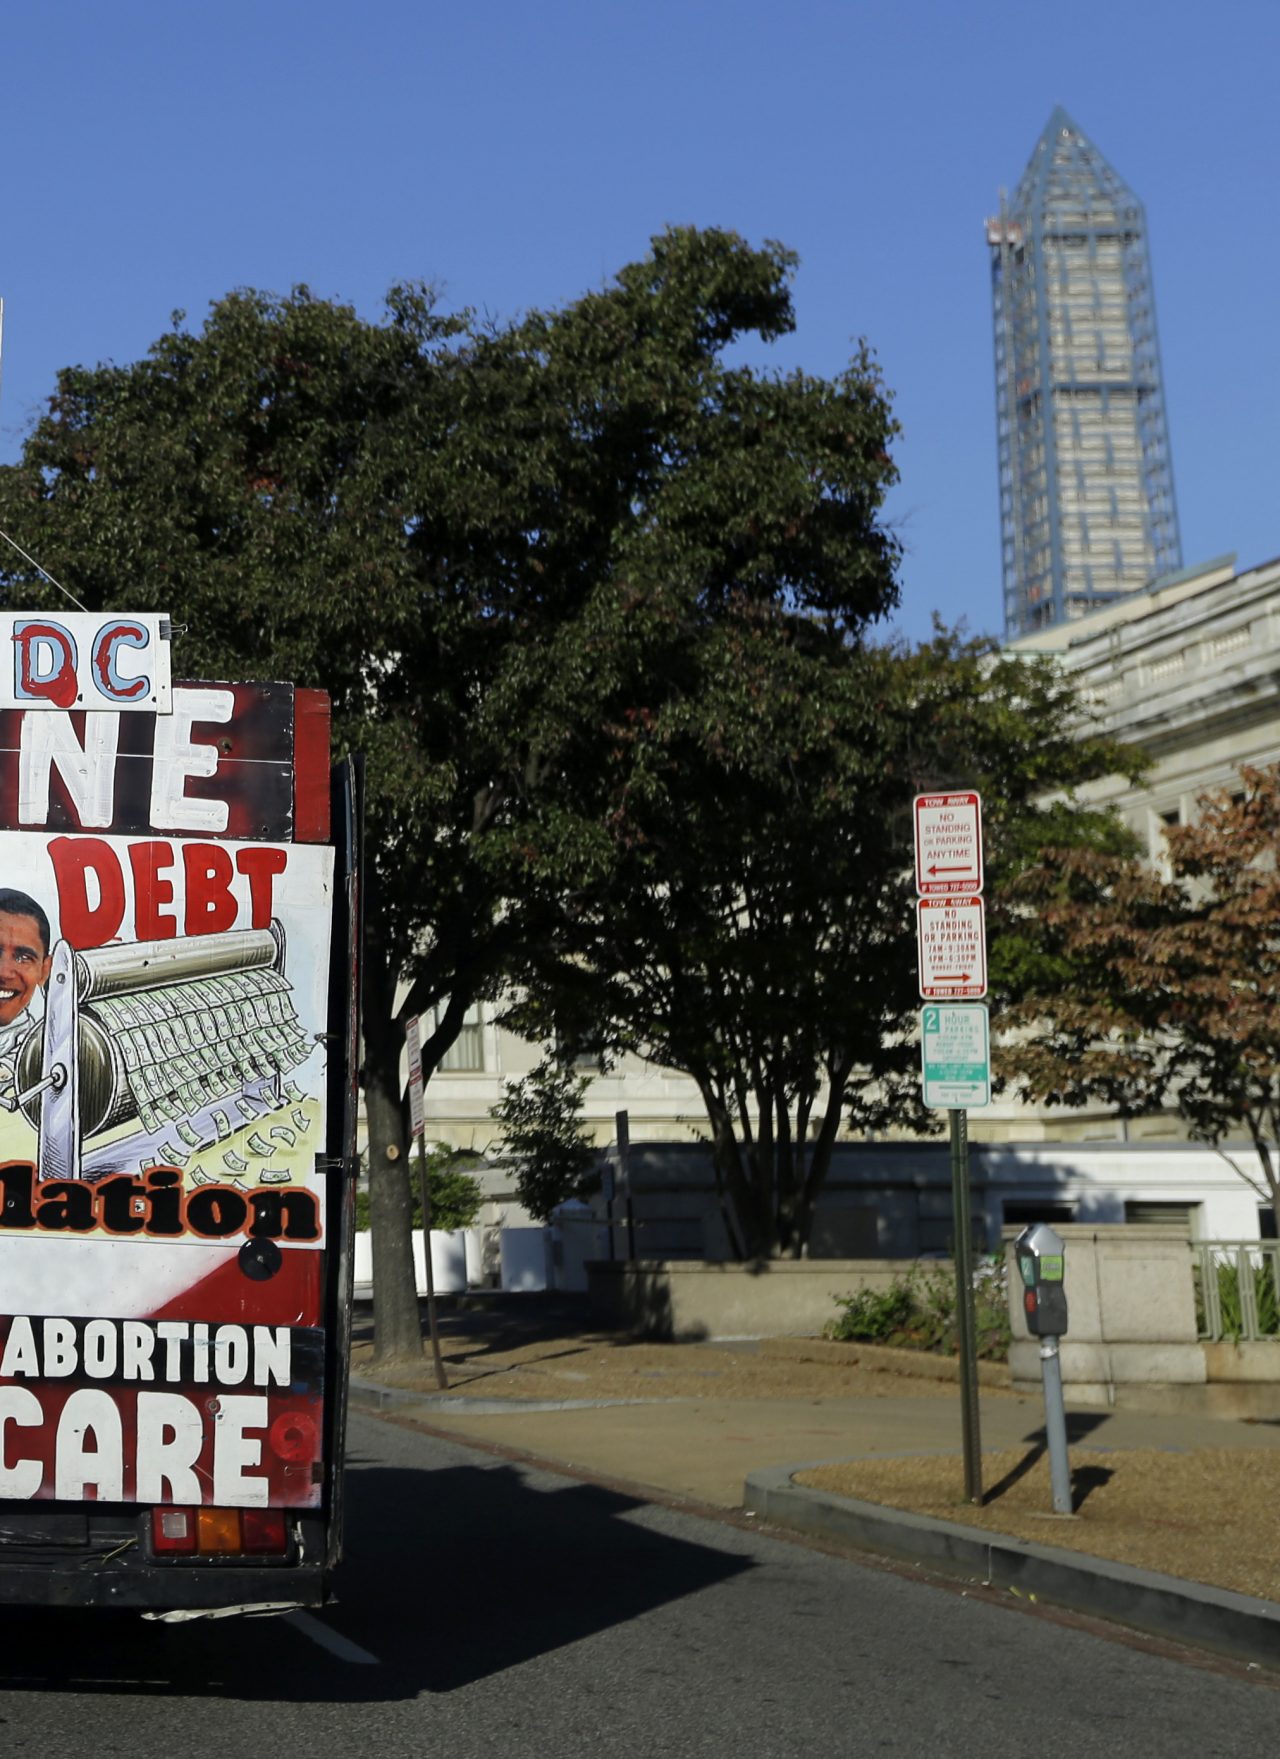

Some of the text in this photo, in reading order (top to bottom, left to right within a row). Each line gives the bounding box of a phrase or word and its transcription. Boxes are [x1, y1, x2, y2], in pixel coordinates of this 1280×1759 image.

[14, 618, 151, 708] DC
[939, 813, 955, 822] NO
[925, 824, 971, 835] STANDING
[935, 836, 973, 846] PARKING
[926, 849, 971, 860] ANYTIME
[47, 836, 287, 949] DEBT
[928, 898, 972, 907] TOW AWAY
[944, 910, 957, 919] NO
[930, 921, 972, 930] STANDING
[925, 932, 978, 942] OR PARKING
[926, 1010, 937, 1030] 2
[944, 1015, 970, 1025] HOUR
[0, 1316, 291, 1387] ABORTION
